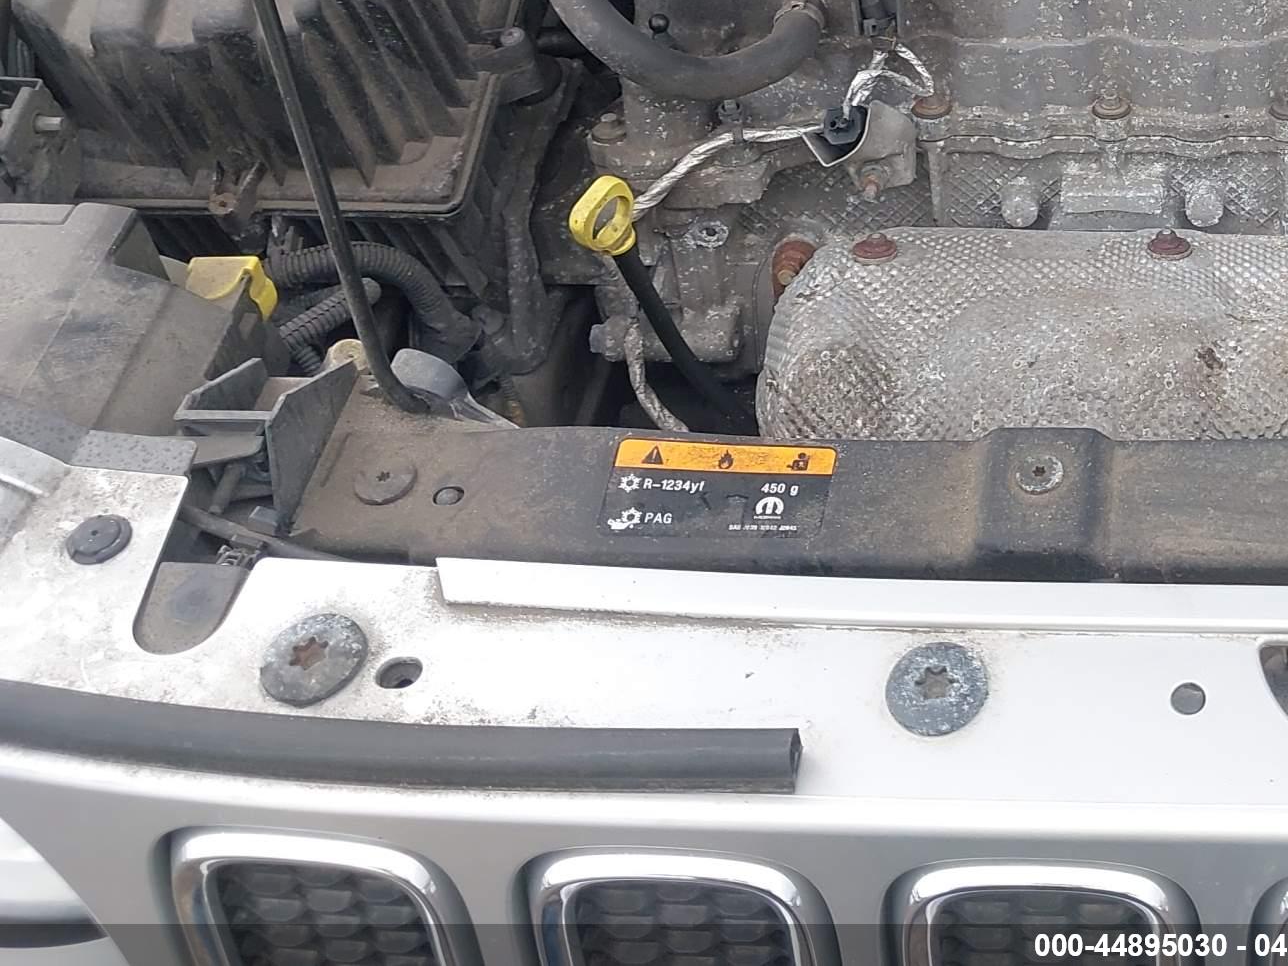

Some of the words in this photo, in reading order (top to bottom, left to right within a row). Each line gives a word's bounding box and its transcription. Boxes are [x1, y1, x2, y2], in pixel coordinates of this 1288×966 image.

[642, 478, 704, 494] R-1234yf
[761, 483, 786, 494] 450
[789, 485, 799, 496] g
[644, 512, 673, 524] PAG
